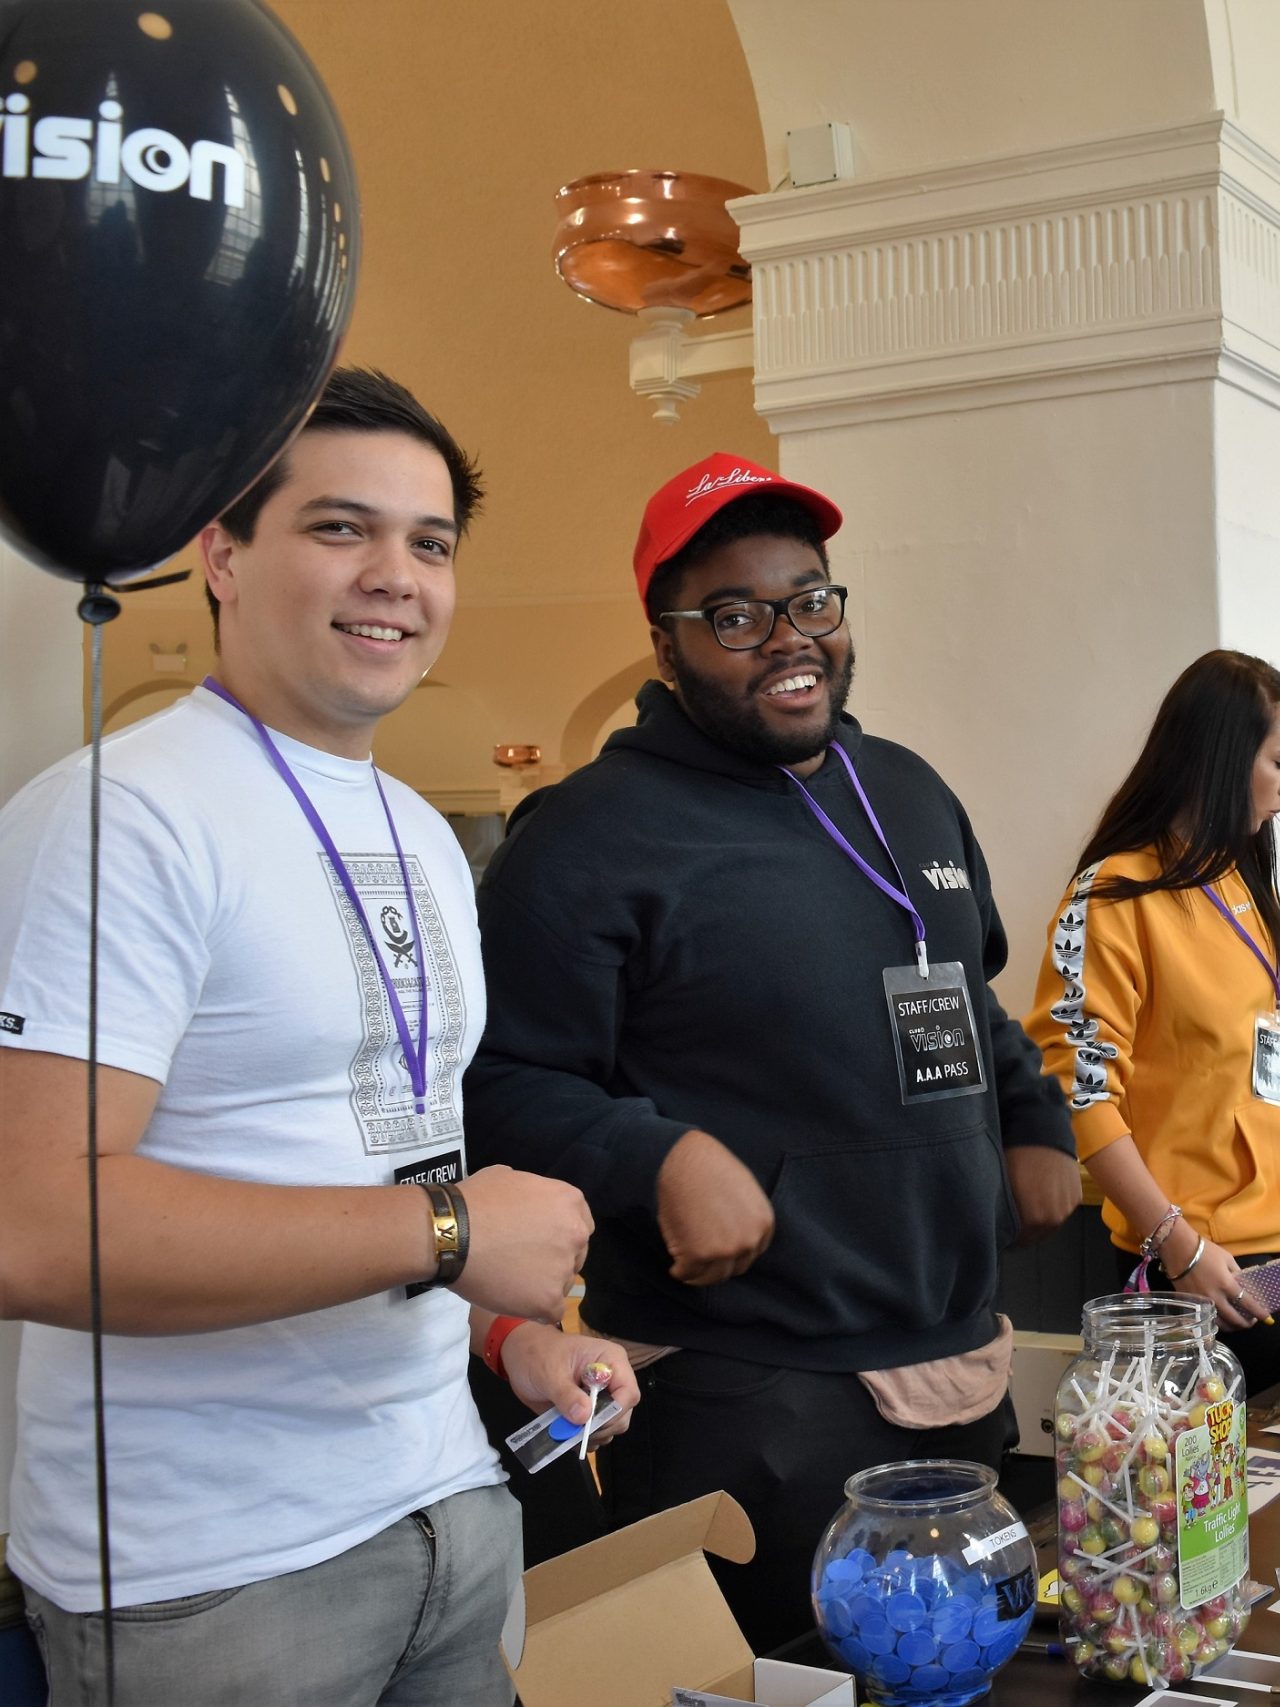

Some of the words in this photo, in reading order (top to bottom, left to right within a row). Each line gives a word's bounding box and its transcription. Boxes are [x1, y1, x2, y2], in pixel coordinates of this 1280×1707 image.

[0, 93, 245, 209] ision
[898, 996, 960, 1017] STAFF/CREW
[944, 1061, 969, 1078] PASS
[1184, 1435, 1198, 1447] 200
[1203, 1512, 1227, 1533] Traffic
[1215, 1522, 1235, 1543] Lollies
[988, 1528, 1017, 1550] TOKENS
